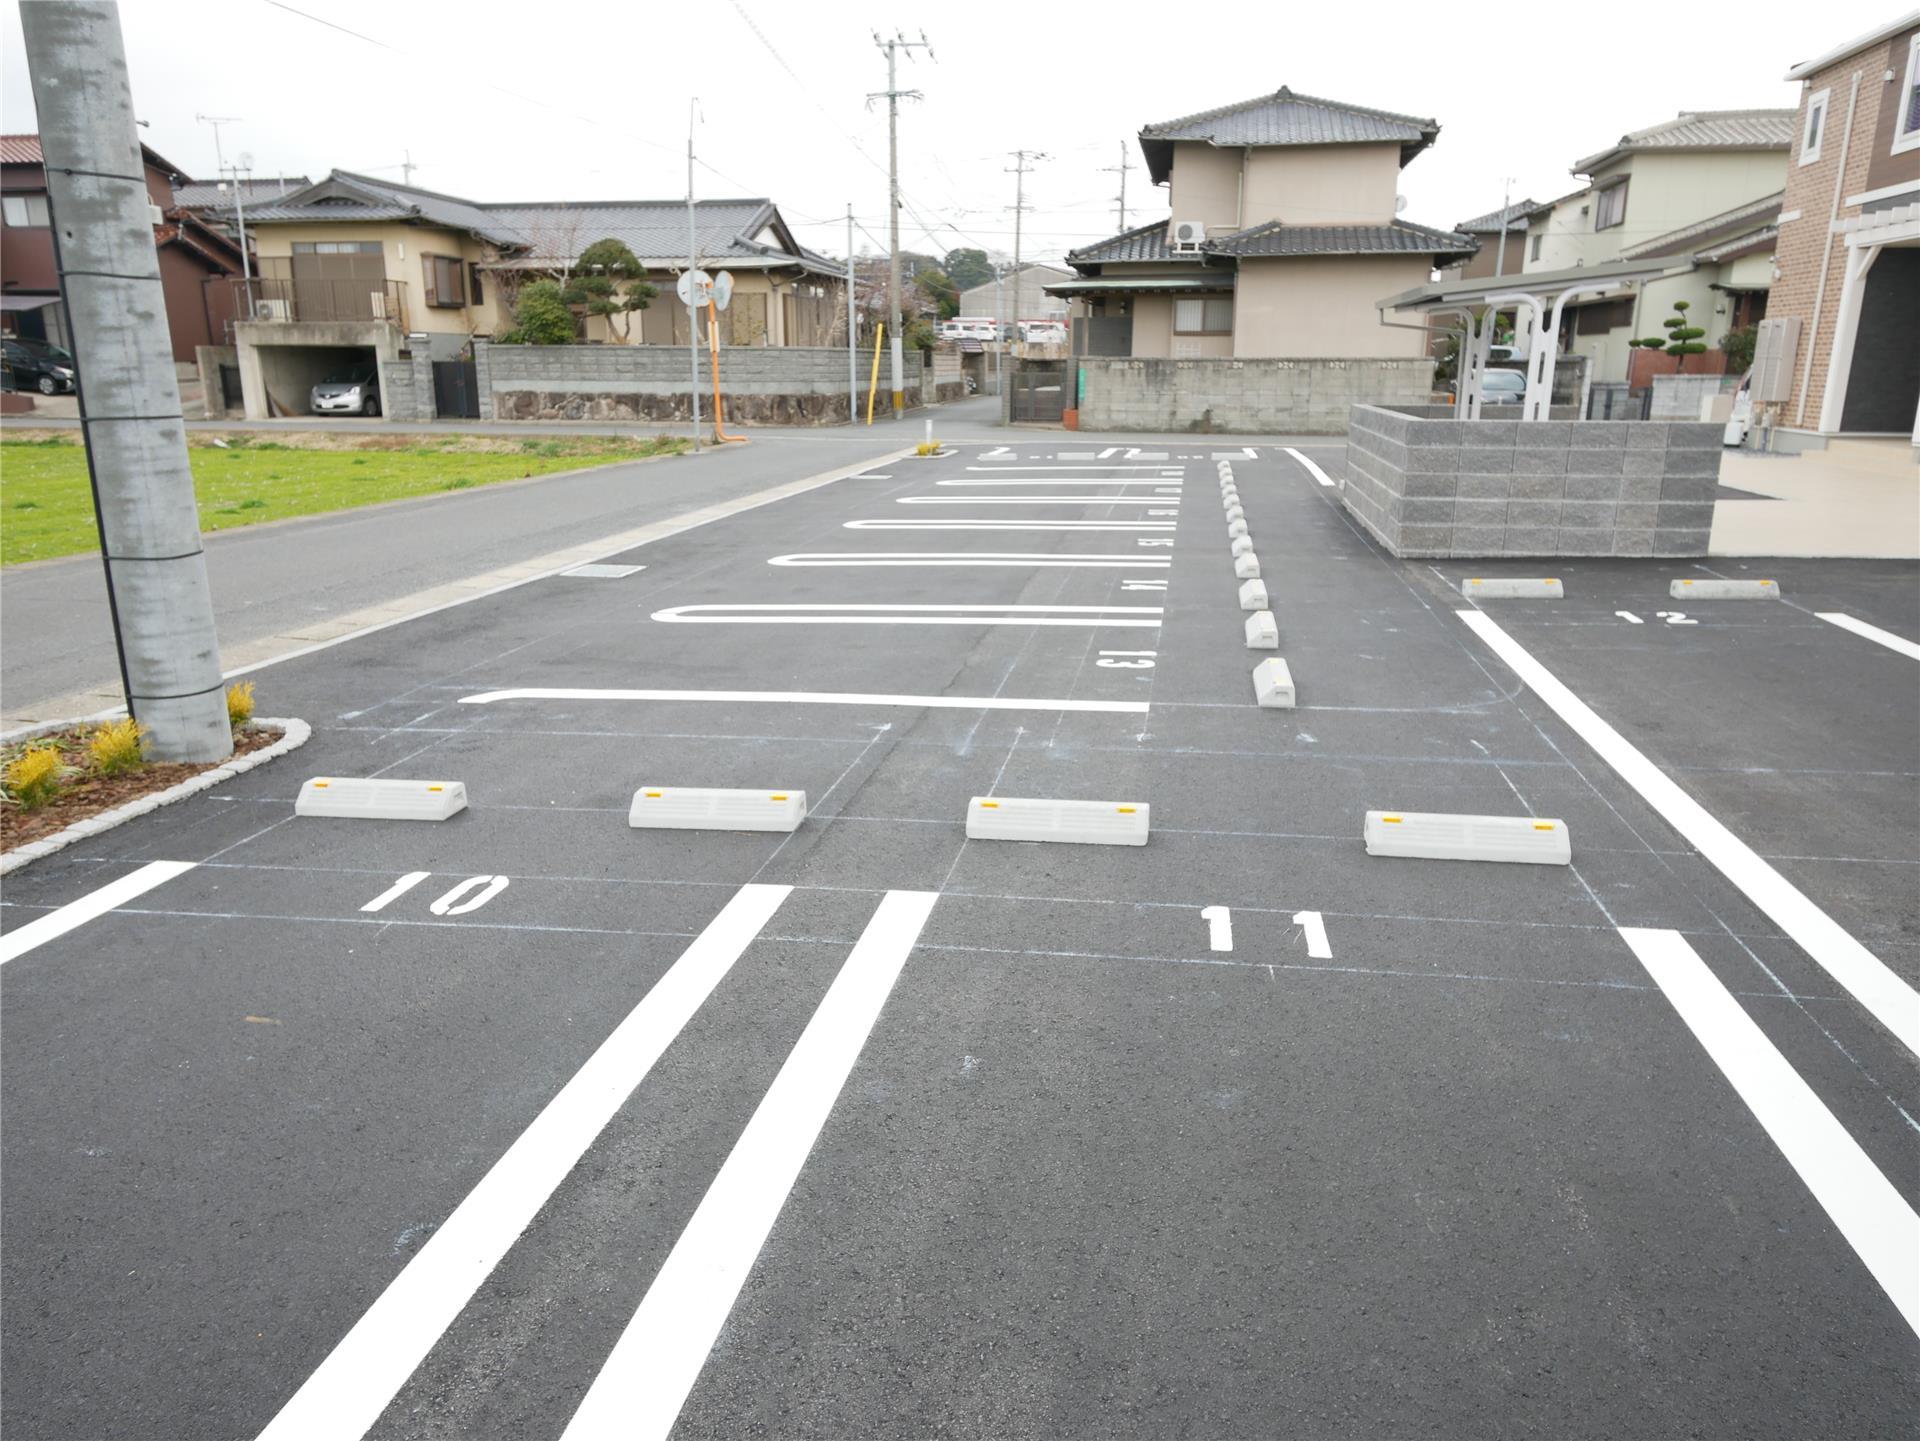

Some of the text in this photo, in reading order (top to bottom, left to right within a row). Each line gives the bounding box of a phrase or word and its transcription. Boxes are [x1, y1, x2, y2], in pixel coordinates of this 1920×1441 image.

[1121, 580, 1168, 590] 14
[1614, 610, 1699, 624] 12
[1095, 650, 1157, 669] 13
[358, 871, 510, 916] 10
[1201, 905, 1333, 959] 11
